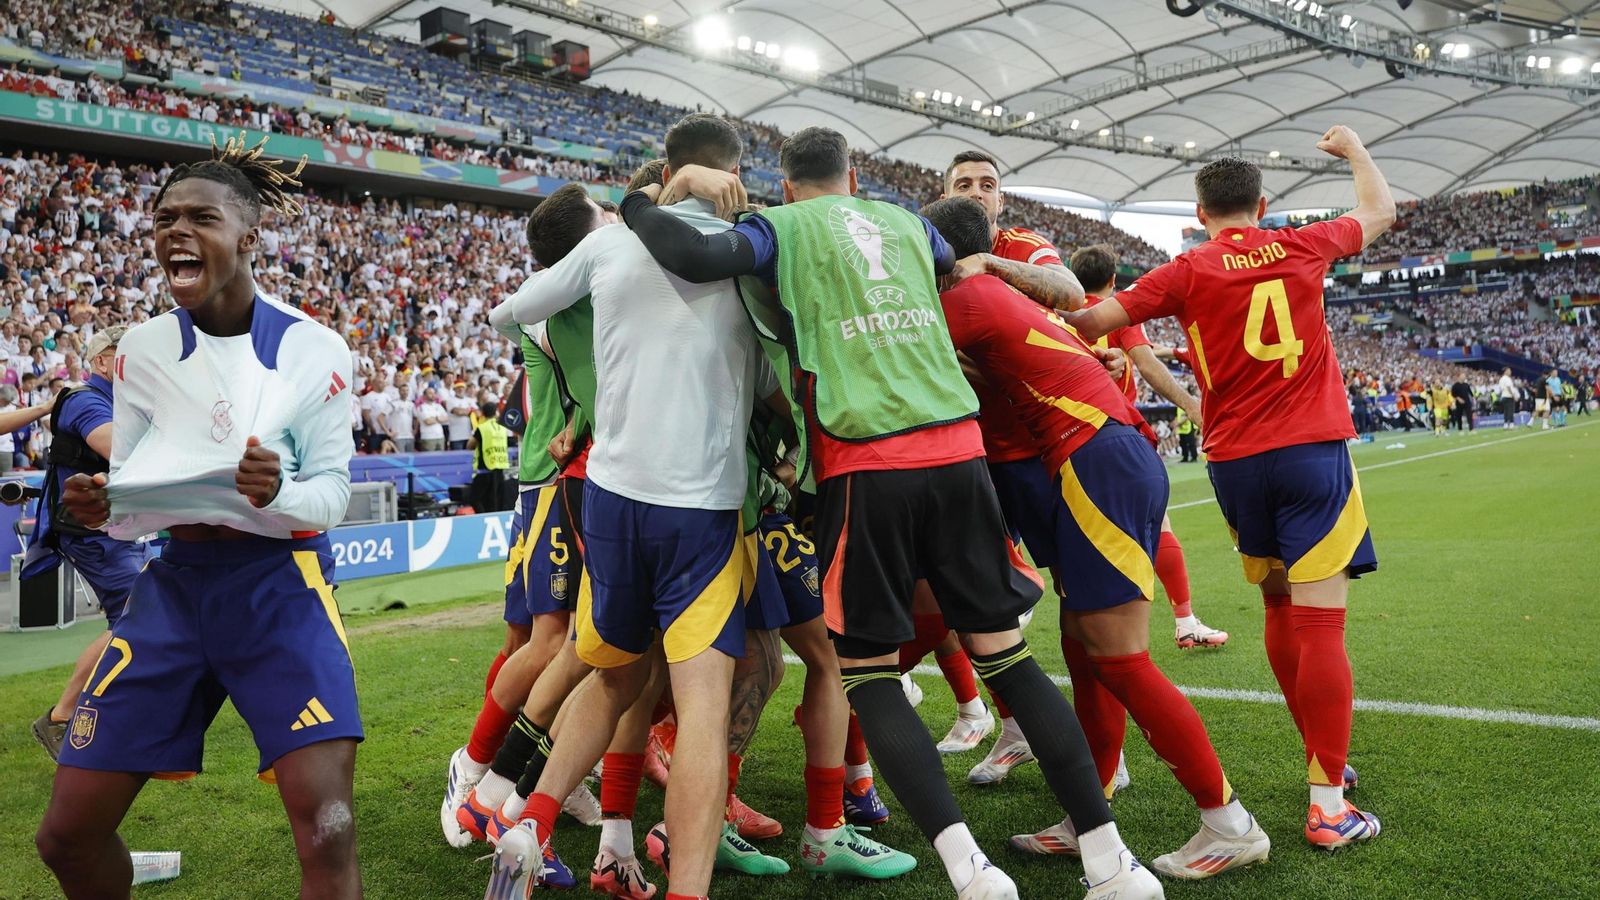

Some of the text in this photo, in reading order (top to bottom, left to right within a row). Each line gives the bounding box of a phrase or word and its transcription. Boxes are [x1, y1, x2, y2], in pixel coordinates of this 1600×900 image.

[36, 99, 234, 146] STUTTGART
[1222, 242, 1286, 270] NACHO
[866, 289, 904, 305] UEFA
[870, 332, 925, 349] GERMANY
[1244, 279, 1303, 378] 4
[332, 538, 394, 567] 2024
[549, 527, 569, 566] 5
